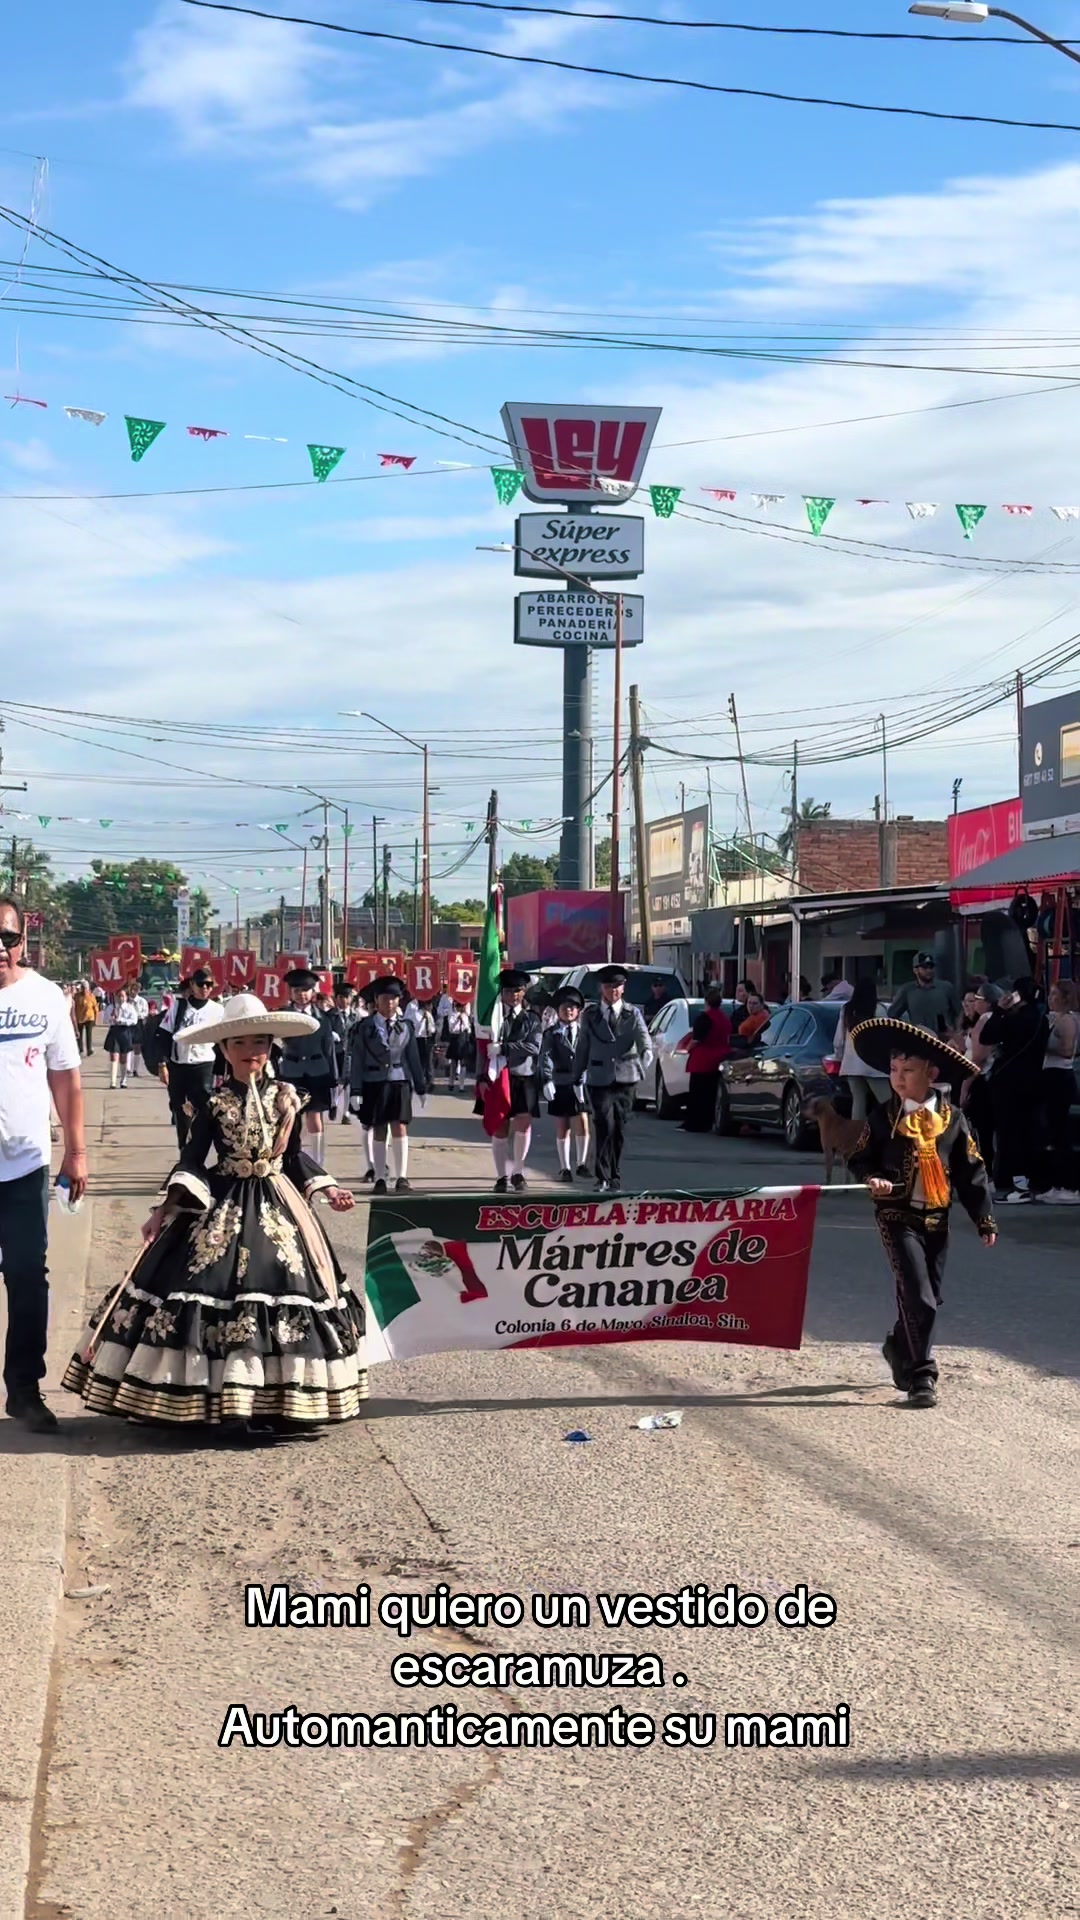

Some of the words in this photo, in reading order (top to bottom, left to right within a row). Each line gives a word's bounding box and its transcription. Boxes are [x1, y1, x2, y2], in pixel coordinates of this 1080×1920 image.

[542, 519, 620, 546] Súper
[531, 545, 630, 566] express
[537, 594, 624, 605] ABARROTE
[553, 630, 609, 641] COCINA
[96, 957, 121, 982] M
[263, 974, 280, 998] R
[414, 966, 432, 990] R
[456, 969, 472, 992] E
[475, 1202, 626, 1231] ESCUELA
[632, 1197, 797, 1225] PRIMARIA
[496, 1232, 697, 1271] Mártires
[708, 1228, 767, 1266] de
[523, 1272, 728, 1308] Cananea
[495, 1317, 556, 1335] Colonia
[561, 1316, 571, 1332] 6
[575, 1315, 597, 1332] de
[717, 1312, 750, 1330] Sin.
